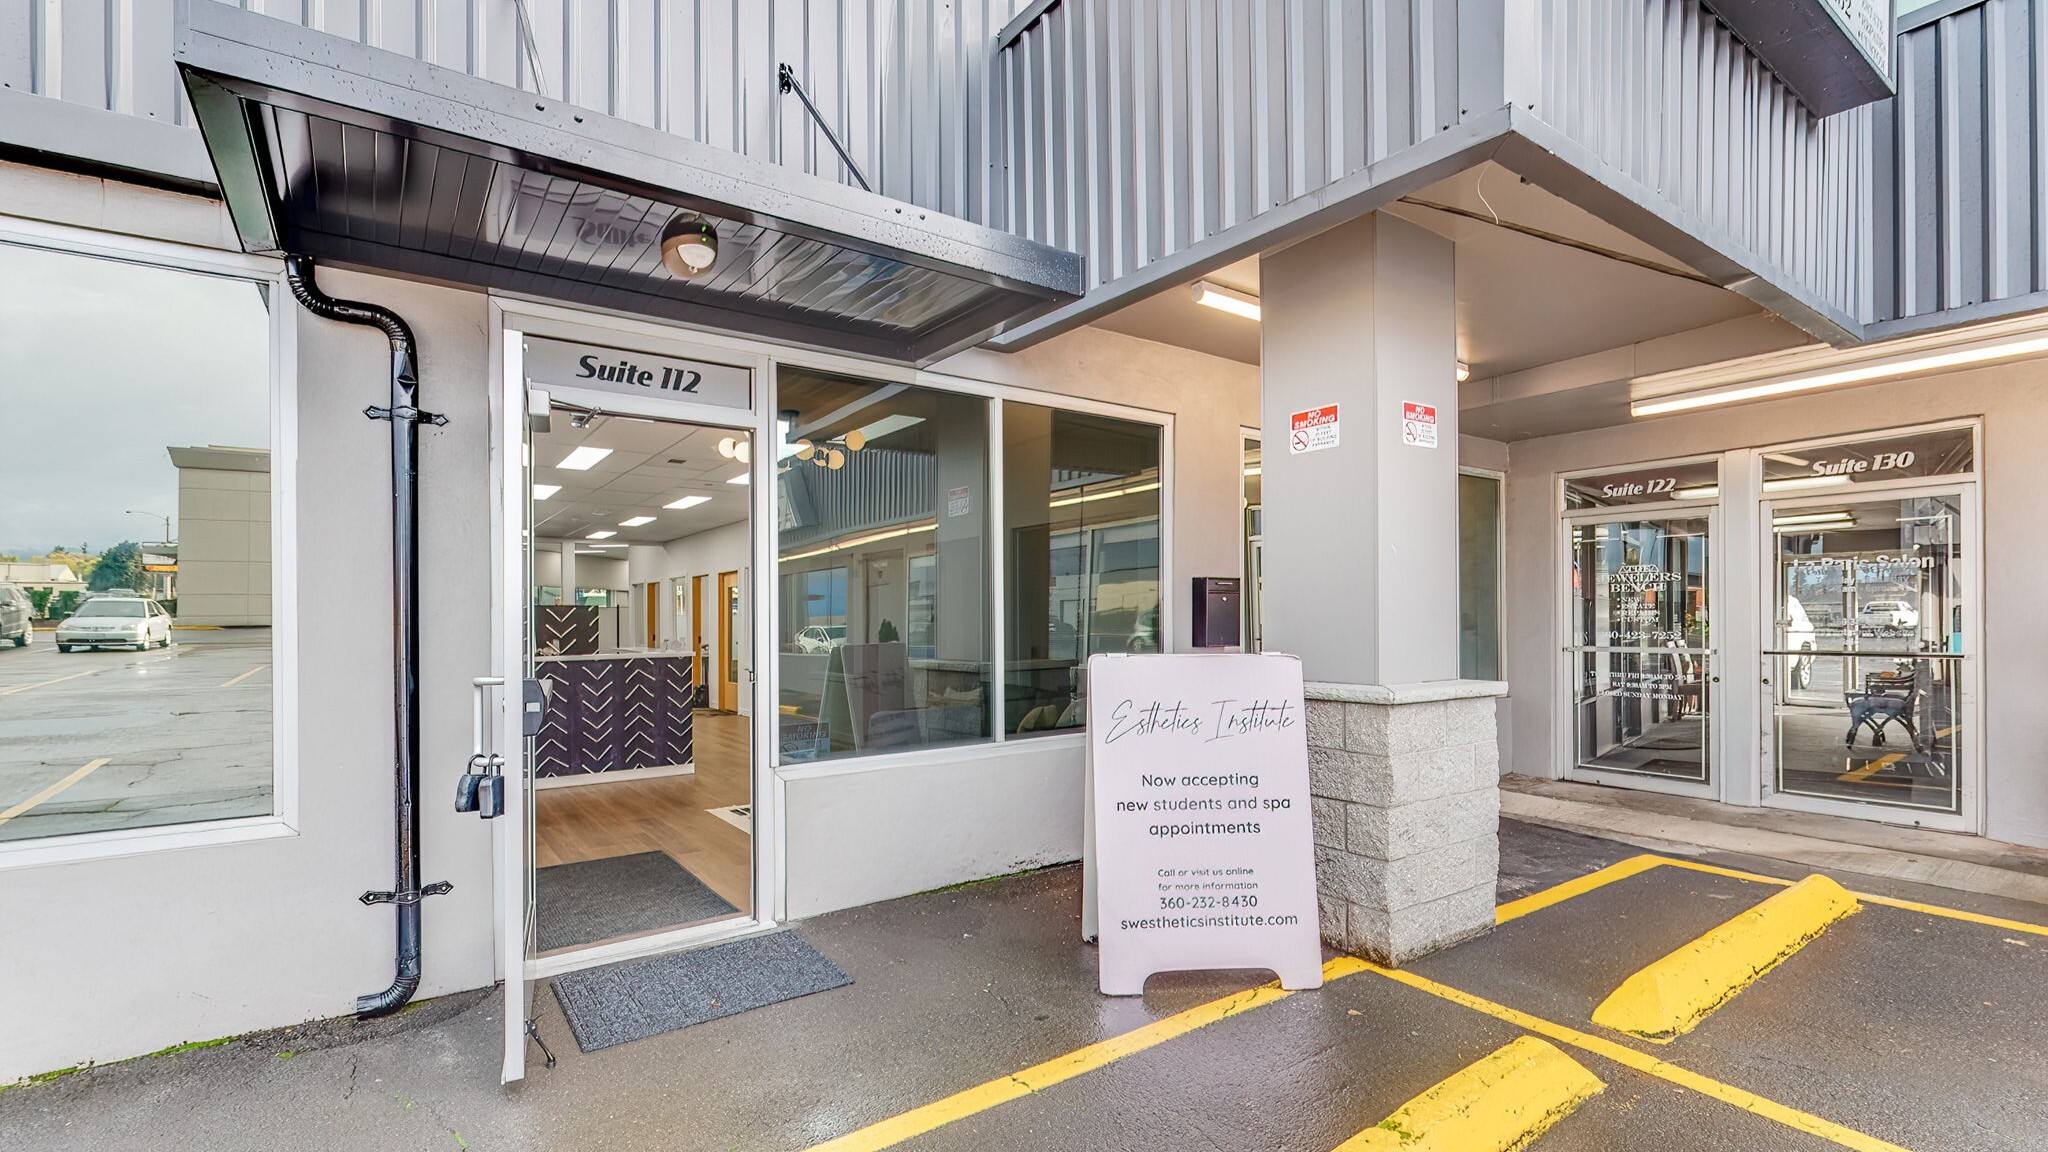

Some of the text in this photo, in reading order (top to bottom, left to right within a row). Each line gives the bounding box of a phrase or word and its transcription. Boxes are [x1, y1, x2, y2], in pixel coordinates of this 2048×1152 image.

[575, 355, 702, 394] Suite 112
[1293, 415, 1336, 430] SMOKING
[1308, 411, 1321, 420] NO
[1811, 451, 1915, 477] Suite 130
[1601, 477, 1677, 498] Suite 122
[1876, 554, 1935, 569] Salon
[1105, 700, 1295, 744] Esthetics Institute
[1141, 773, 1259, 789] Now accepting
[1117, 797, 1291, 812] new students and spa
[1149, 821, 1261, 838] appointments
[1158, 868, 1176, 877] Call
[1178, 869, 1187, 877] or
[1191, 868, 1209, 876] visit
[1226, 867, 1254, 876] online
[1158, 883, 1171, 892] for
[1202, 882, 1258, 891] information
[1160, 895, 1258, 910] 360-232-8430
[1121, 914, 1298, 930] swestheticsinstitute.com
